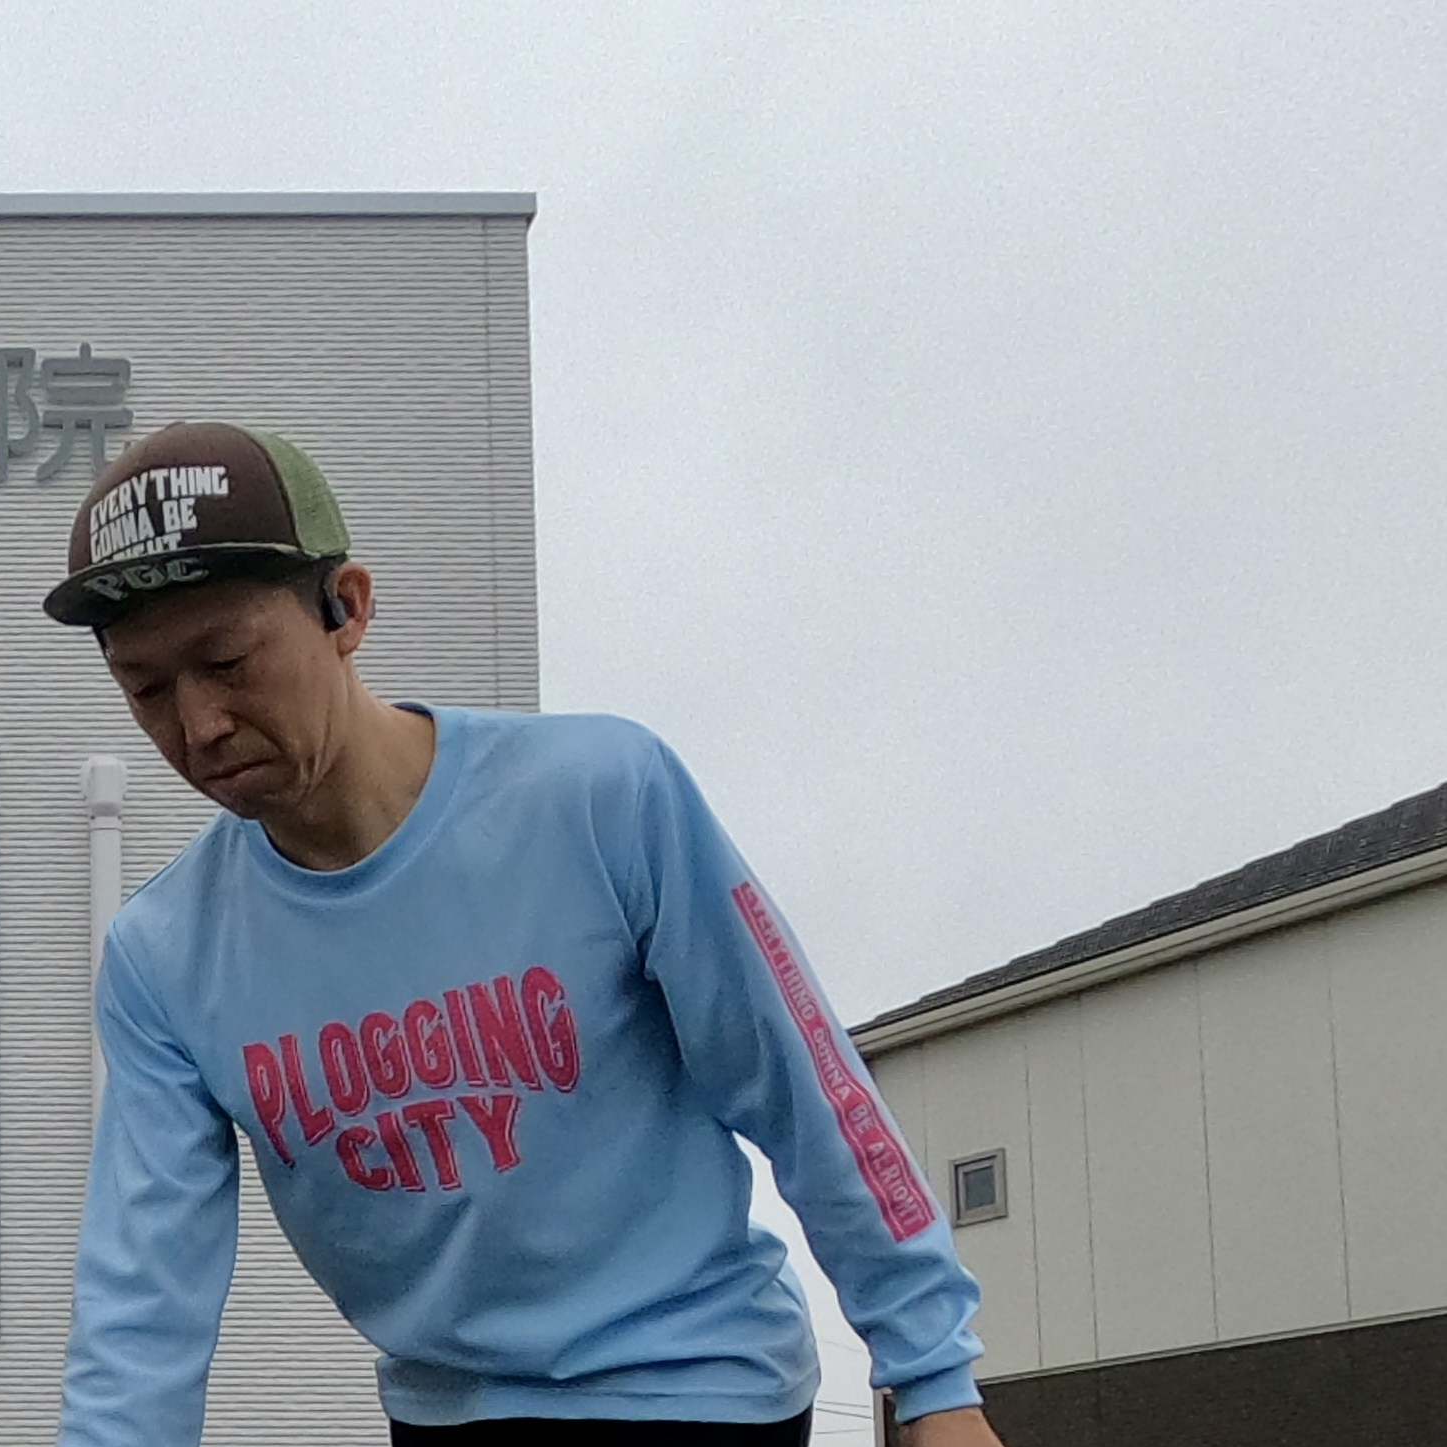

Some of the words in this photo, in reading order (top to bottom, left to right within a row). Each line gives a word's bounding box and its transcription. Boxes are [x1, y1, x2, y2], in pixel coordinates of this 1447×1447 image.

[90, 465, 229, 533] EVERYTHING
[90, 507, 155, 564] GONNA
[162, 497, 198, 533] BE
[242, 965, 580, 1170] PLOGGING
[335, 1093, 523, 1193] CITY
[848, 1102, 875, 1134] BE
